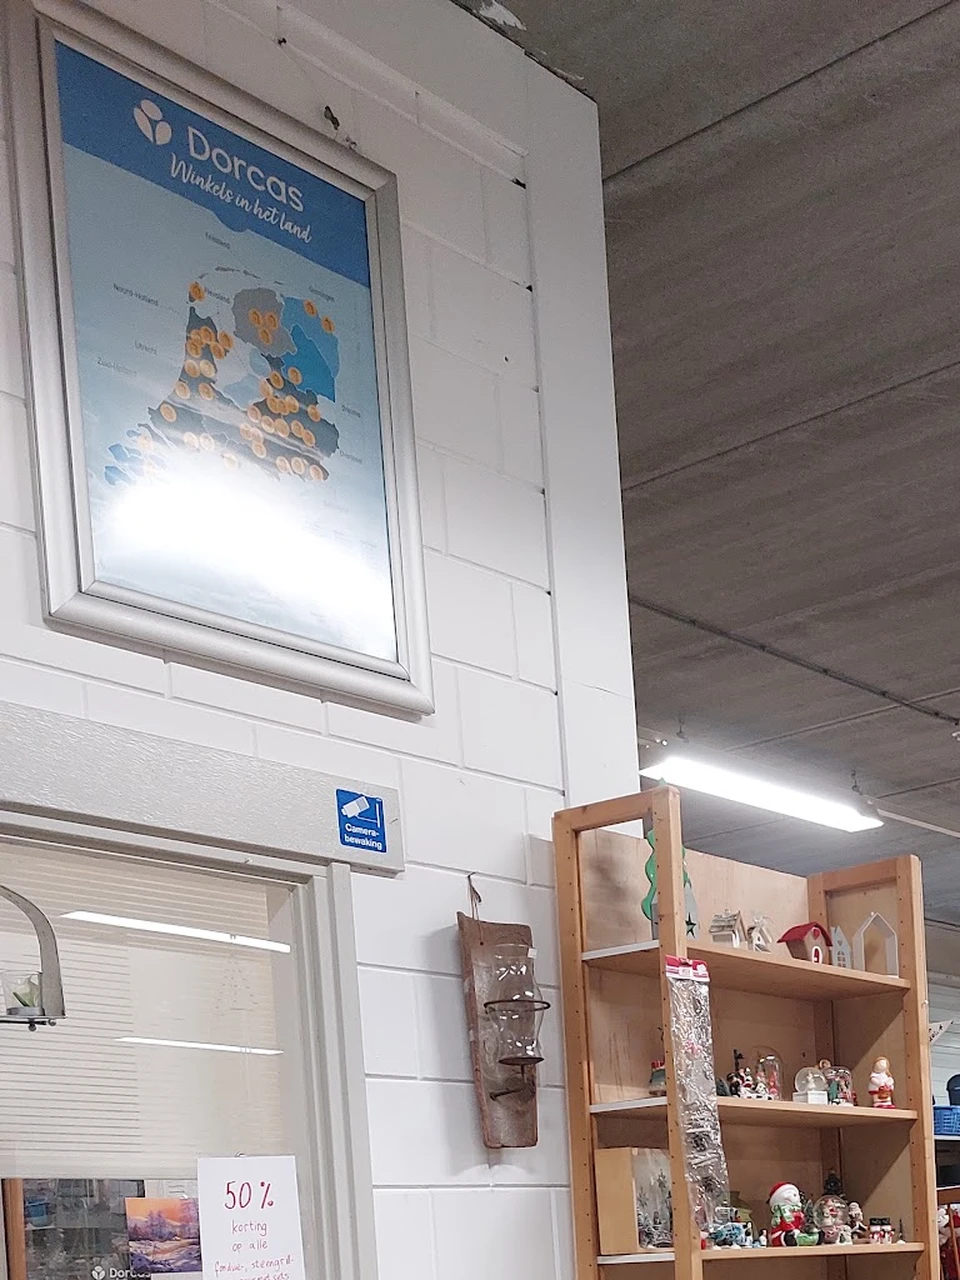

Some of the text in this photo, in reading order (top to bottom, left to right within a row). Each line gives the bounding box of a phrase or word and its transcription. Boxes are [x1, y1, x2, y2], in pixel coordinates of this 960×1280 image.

[187, 125, 304, 212] Dorcas
[171, 152, 312, 243] Winkels in het land
[345, 823, 380, 838] Camera-
[344, 834, 383, 850] bewaking
[231, 1220, 267, 1236] korting
[232, 1240, 268, 1253] op alle
